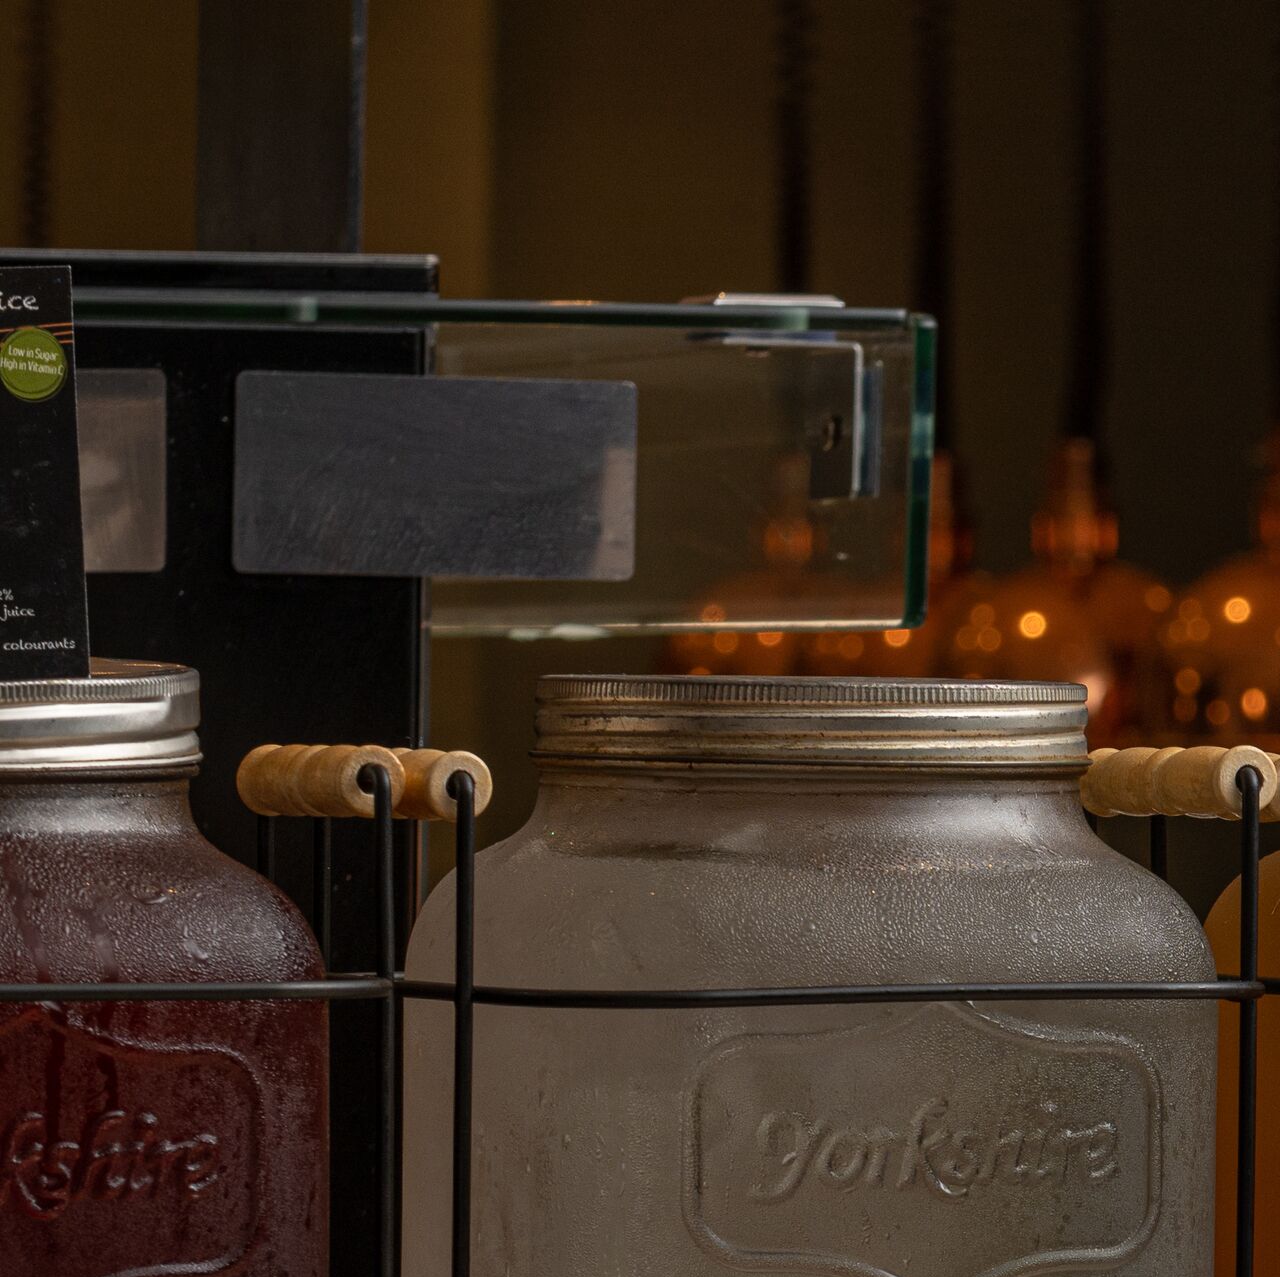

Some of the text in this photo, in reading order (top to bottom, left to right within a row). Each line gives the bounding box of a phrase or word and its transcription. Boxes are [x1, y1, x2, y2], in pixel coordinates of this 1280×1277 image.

[8, 344, 59, 362] Low in Sugar
[0, 357, 64, 376] High in Vitamin C
[0, 604, 36, 622] juice
[3, 638, 76, 651] colourants
